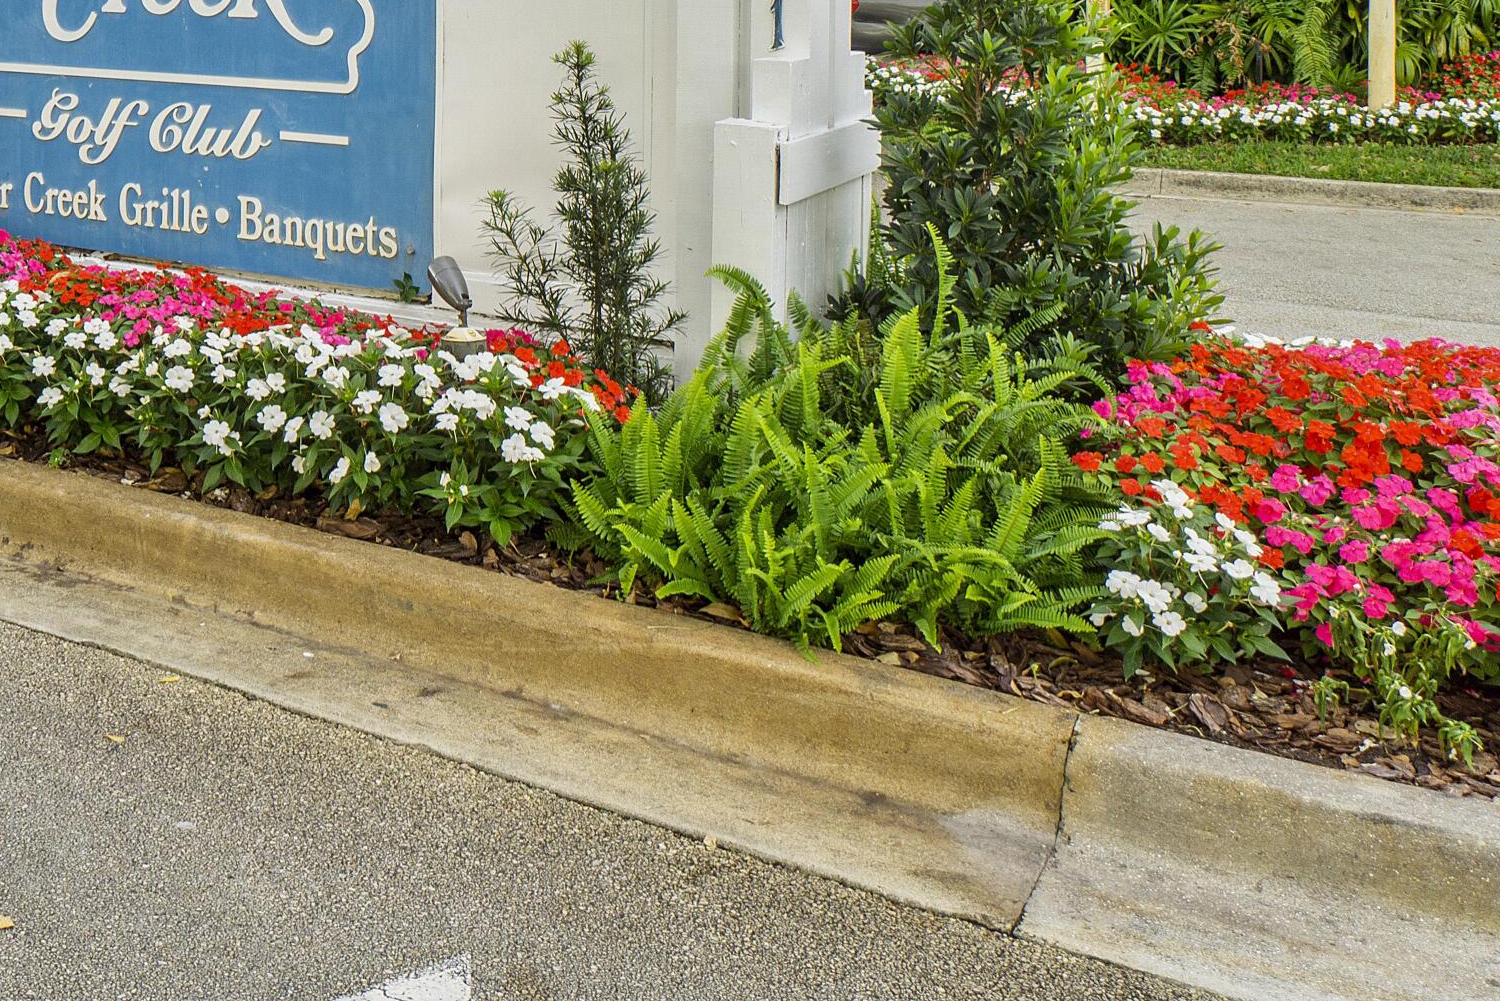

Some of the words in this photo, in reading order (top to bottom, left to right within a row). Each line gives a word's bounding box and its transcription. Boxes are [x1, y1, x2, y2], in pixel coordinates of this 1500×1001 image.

[31, 86, 149, 165] Golf
[148, 101, 272, 160] Club
[23, 171, 108, 223] Creek
[119, 182, 210, 236] Grille
[236, 195, 399, 261] Banquets
